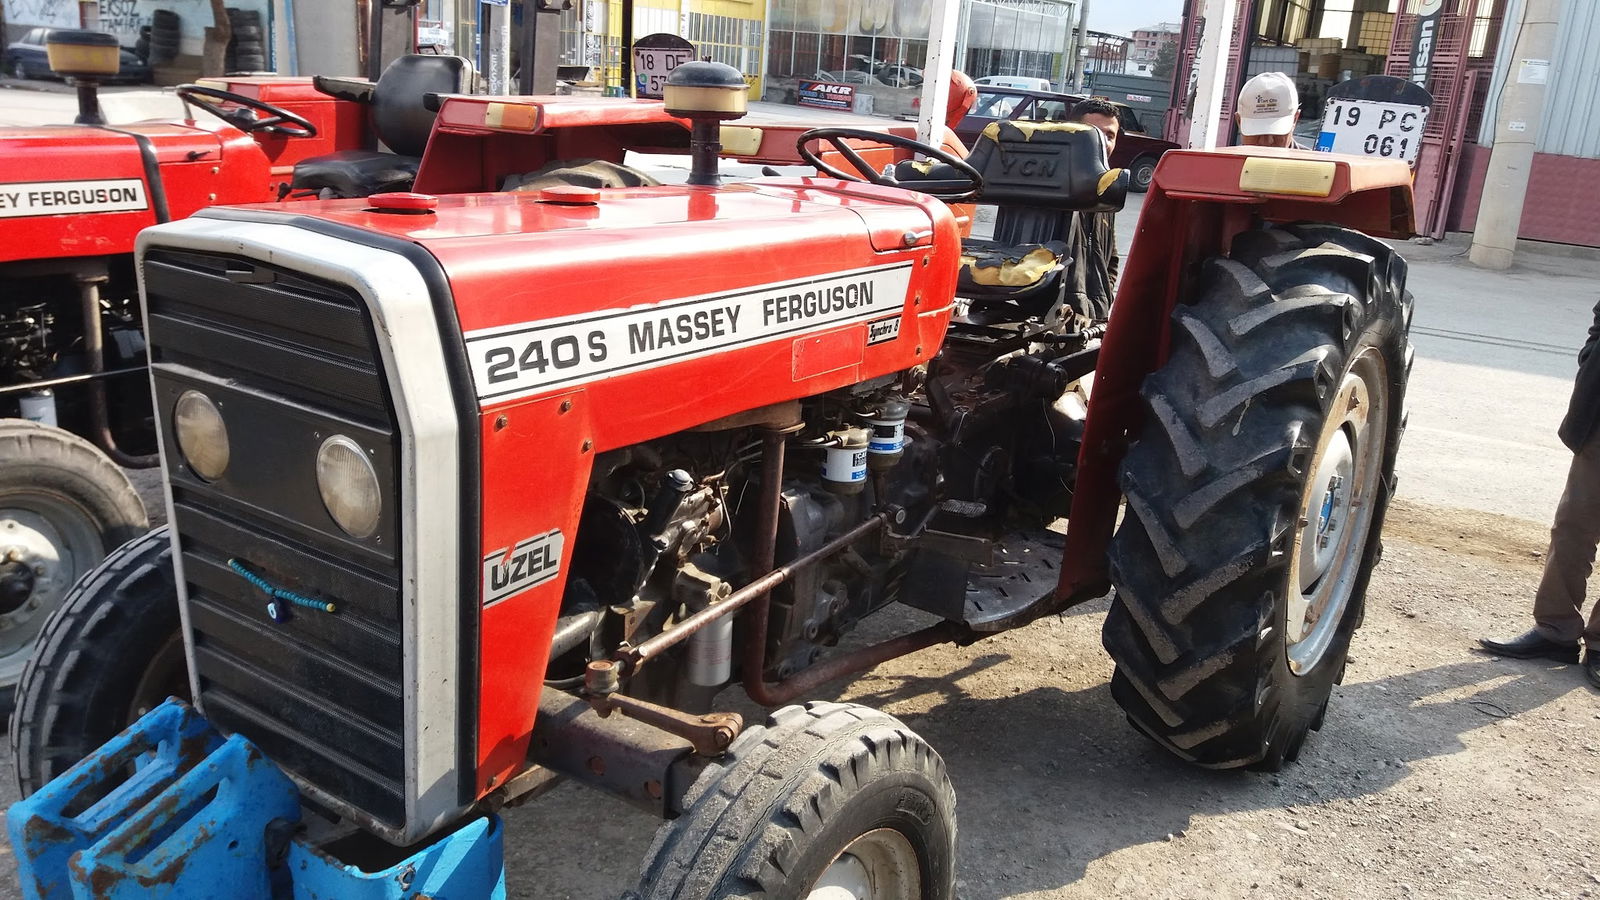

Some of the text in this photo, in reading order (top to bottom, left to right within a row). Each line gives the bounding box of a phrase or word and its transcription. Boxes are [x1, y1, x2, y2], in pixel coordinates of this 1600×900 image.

[640, 54, 655, 70] 18
[812, 84, 852, 95] AKR
[1333, 105, 1417, 132] 19 PC
[1363, 133, 1409, 159] 061
[1000, 159, 1060, 177] YCN
[28, 187, 138, 208] FERGUSON
[628, 304, 742, 355] MASSEY
[763, 280, 874, 326] FERGUSON
[869, 322, 893, 341] Synchro
[491, 543, 557, 591] UZEL
